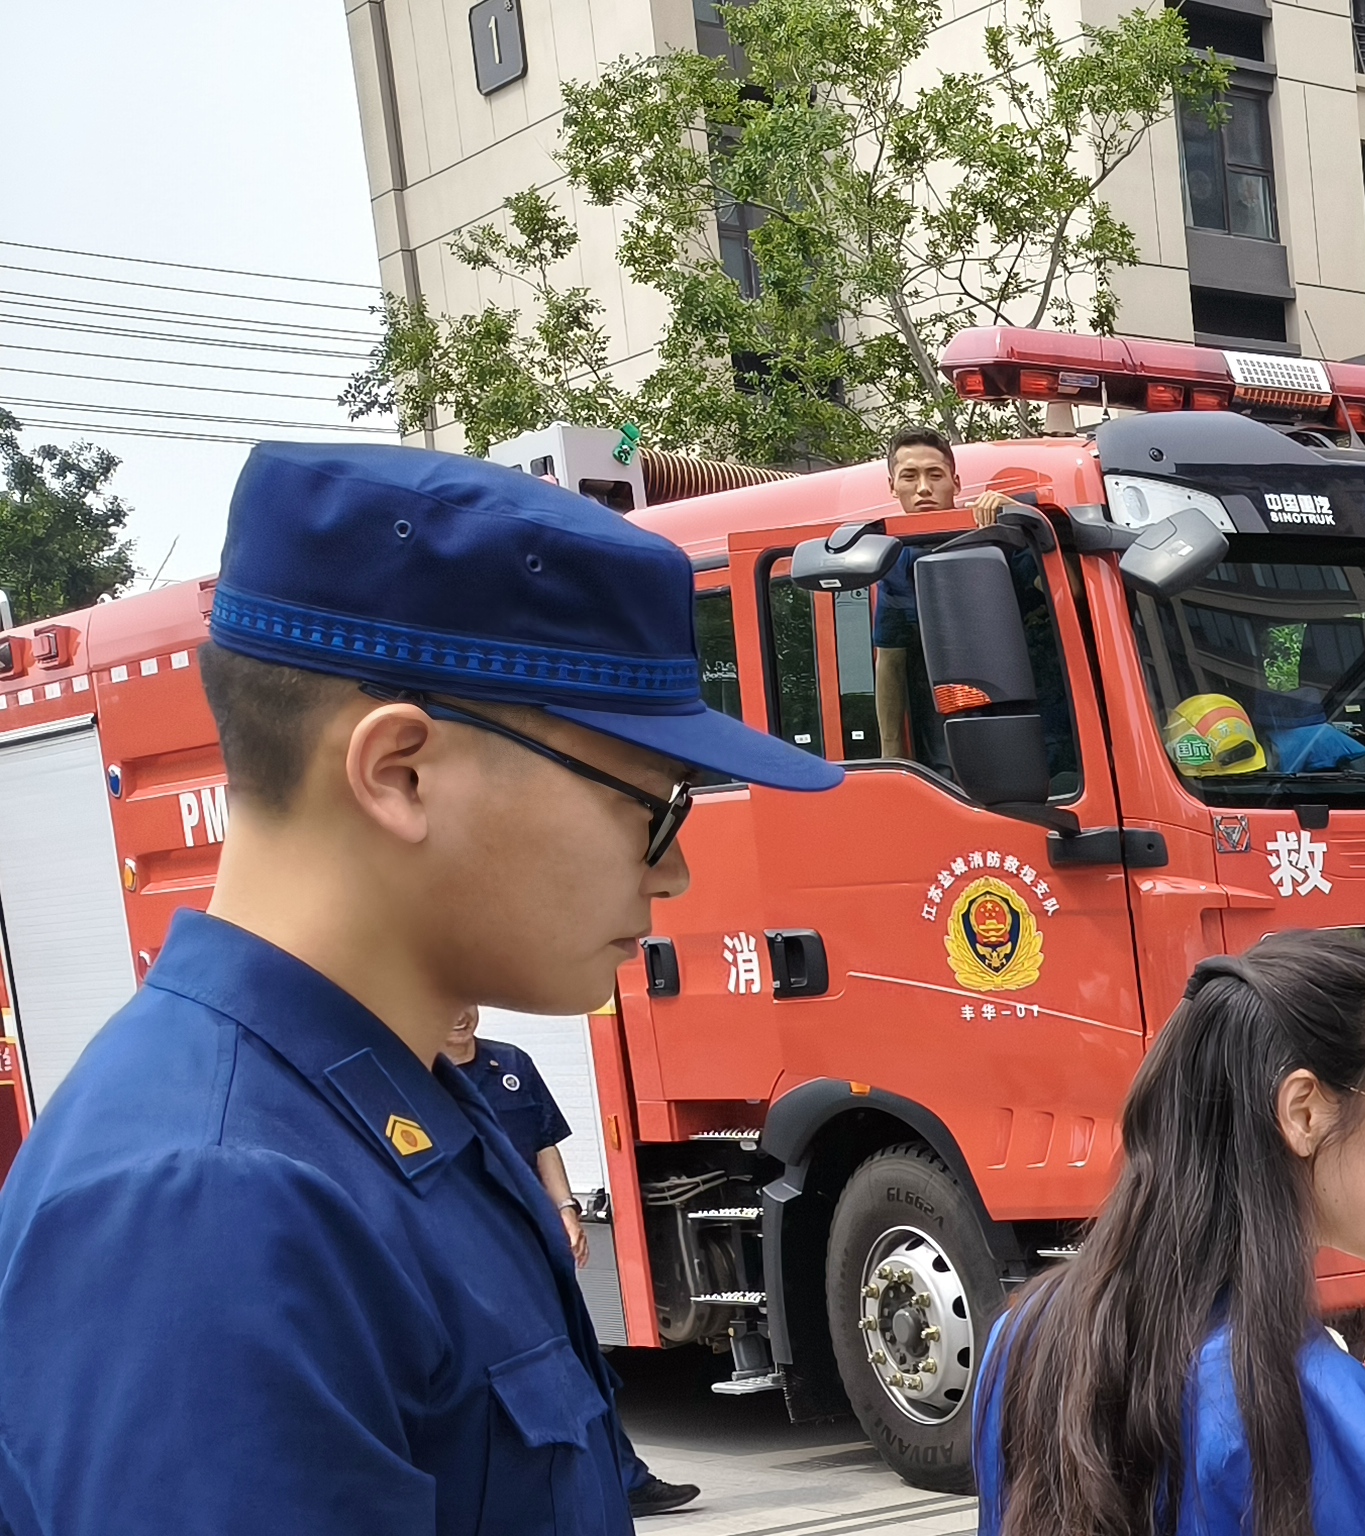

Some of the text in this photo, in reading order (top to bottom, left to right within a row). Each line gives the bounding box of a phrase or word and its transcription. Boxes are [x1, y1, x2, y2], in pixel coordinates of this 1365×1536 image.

[488, 15, 501, 64] 1
[1269, 511, 1336, 525] SINOTRUK
[921, 850, 1060, 921] 江苏盐城消防救援支队
[1266, 829, 1333, 897] 救
[723, 931, 761, 994] 消
